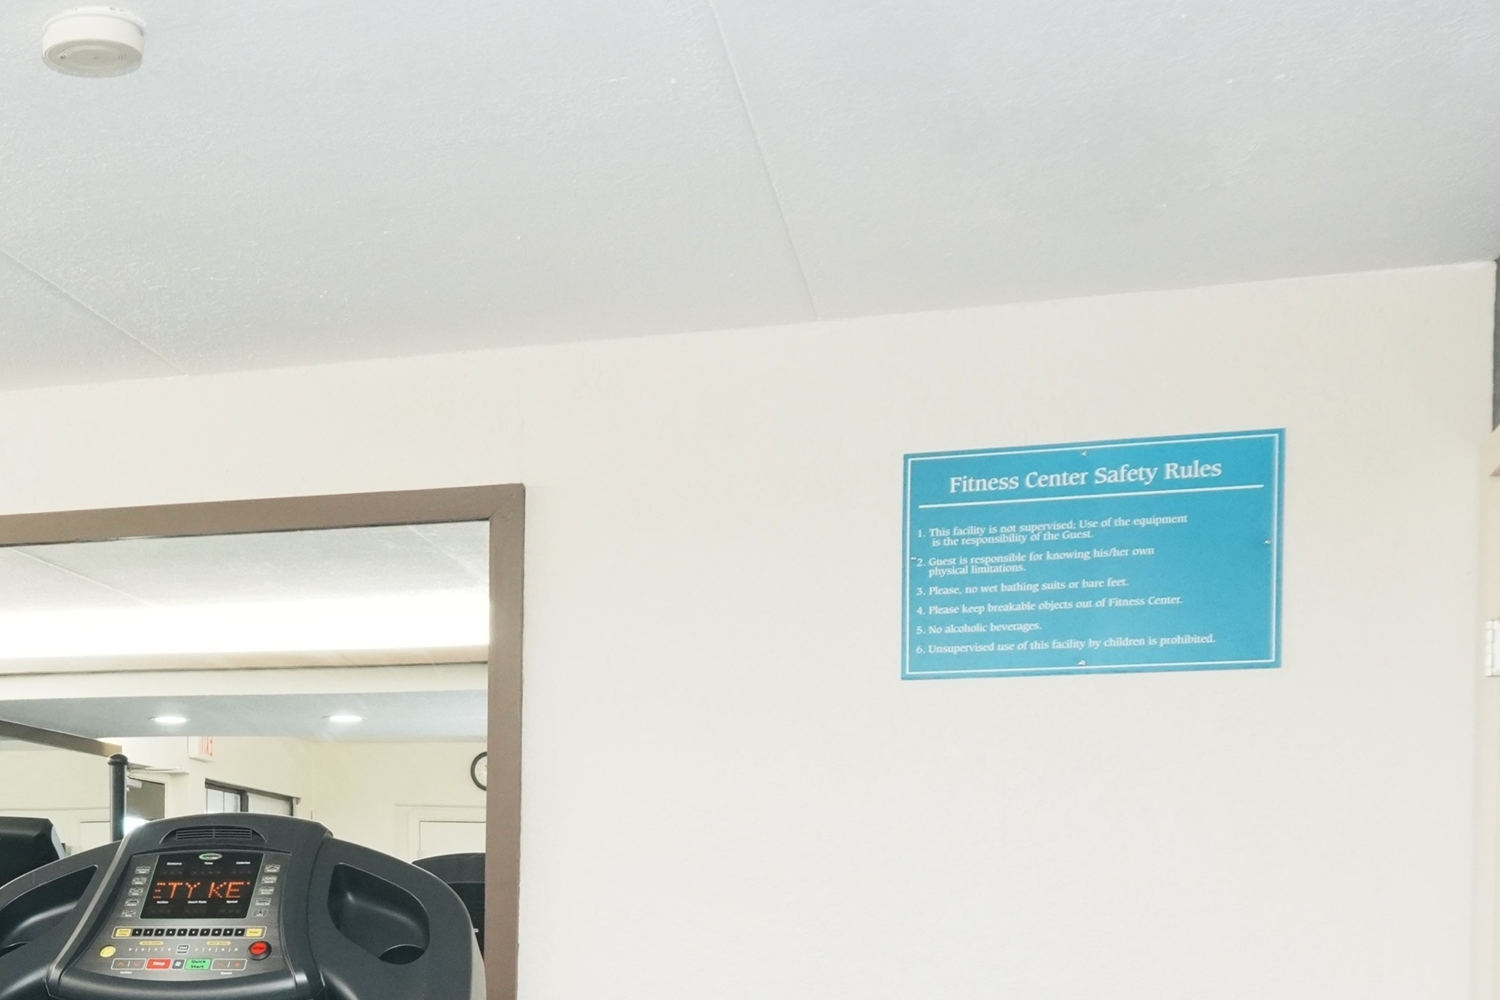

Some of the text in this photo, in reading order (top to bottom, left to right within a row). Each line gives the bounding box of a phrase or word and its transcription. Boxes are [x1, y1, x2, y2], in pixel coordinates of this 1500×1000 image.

[950, 460, 1222, 493] Fitness Center Safety Rules
[918, 529, 926, 538] 1.
[929, 527, 951, 537] This
[953, 525, 986, 536] facility
[989, 524, 998, 534] is
[1000, 524, 1017, 533] not
[1079, 519, 1098, 529] Use
[1101, 517, 1113, 527] of
[1114, 517, 1130, 526] the
[1133, 515, 1188, 528] equipment
[932, 530, 1093, 547] is the responsibility of the Guest.
[916, 547, 1155, 567] 2. Guest is responsible for knowing his/her own
[929, 563, 1026, 578] physical limitations.
[916, 587, 926, 596] 3.
[965, 585, 978, 594] no
[980, 584, 998, 593] wet
[1001, 582, 1039, 593] bathing
[1042, 580, 1066, 590] suits
[1068, 581, 1079, 589] or
[1082, 579, 1104, 588] bare
[1107, 577, 1129, 587] feet.
[916, 596, 1183, 615] 4. Please keep breakable objects out of Fitness Center.
[916, 622, 1043, 635] 5. No alcoholic beverages.
[916, 633, 1216, 655] 6. Unsupervised use of this facility by children is prohibited.
